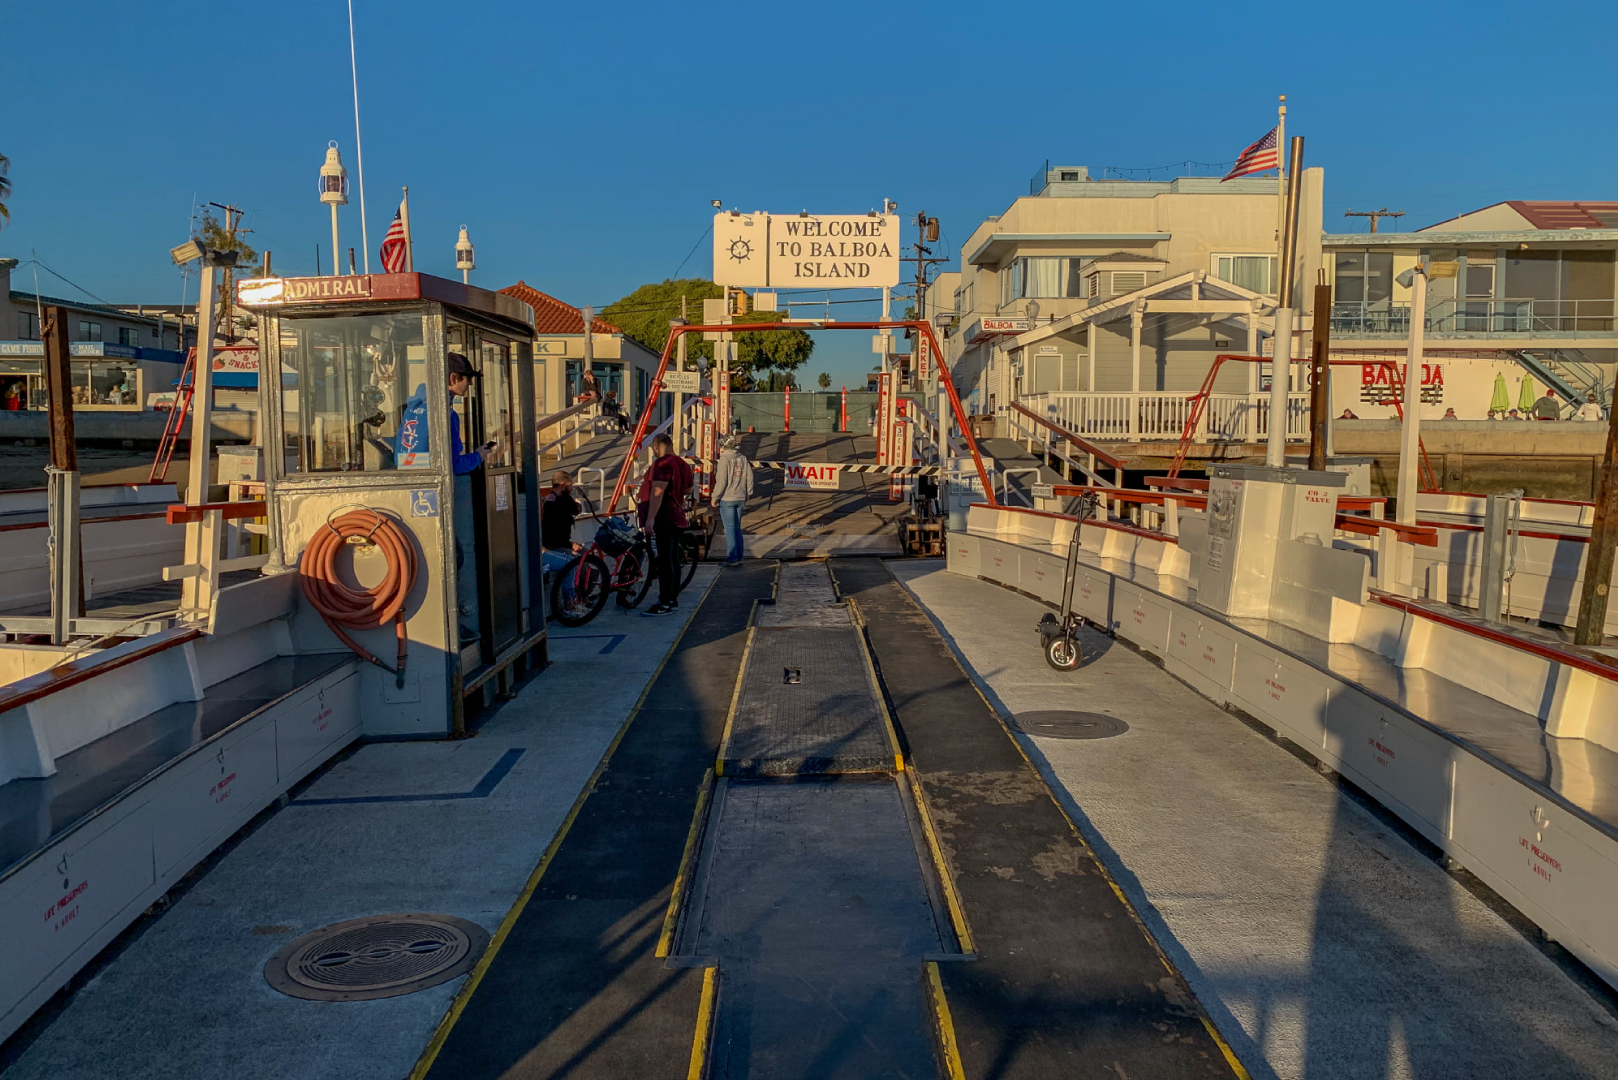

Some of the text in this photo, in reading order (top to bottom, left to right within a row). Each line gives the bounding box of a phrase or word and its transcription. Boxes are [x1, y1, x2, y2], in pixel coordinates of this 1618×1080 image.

[785, 221, 882, 237] WELCOME
[776, 242, 893, 258] TO BALBOA
[794, 262, 870, 278] ISLAND
[285, 279, 369, 298] ADMIRAL
[983, 320, 1013, 329] BALBOA
[228, 359, 259, 369] SNACK
[920, 331, 928, 378] MARKET
[1362, 364, 1444, 386] BALOA
[894, 438, 902, 487] CAUTON
[787, 466, 838, 480] WAIT
[1305, 496, 1331, 504] VALVE
[1519, 836, 1562, 872] LIFE PRESERVERS
[1533, 863, 1552, 882] ADULT
[44, 880, 88, 922] LIFE PRESERVERS
[61, 905, 79, 928] ADULT
